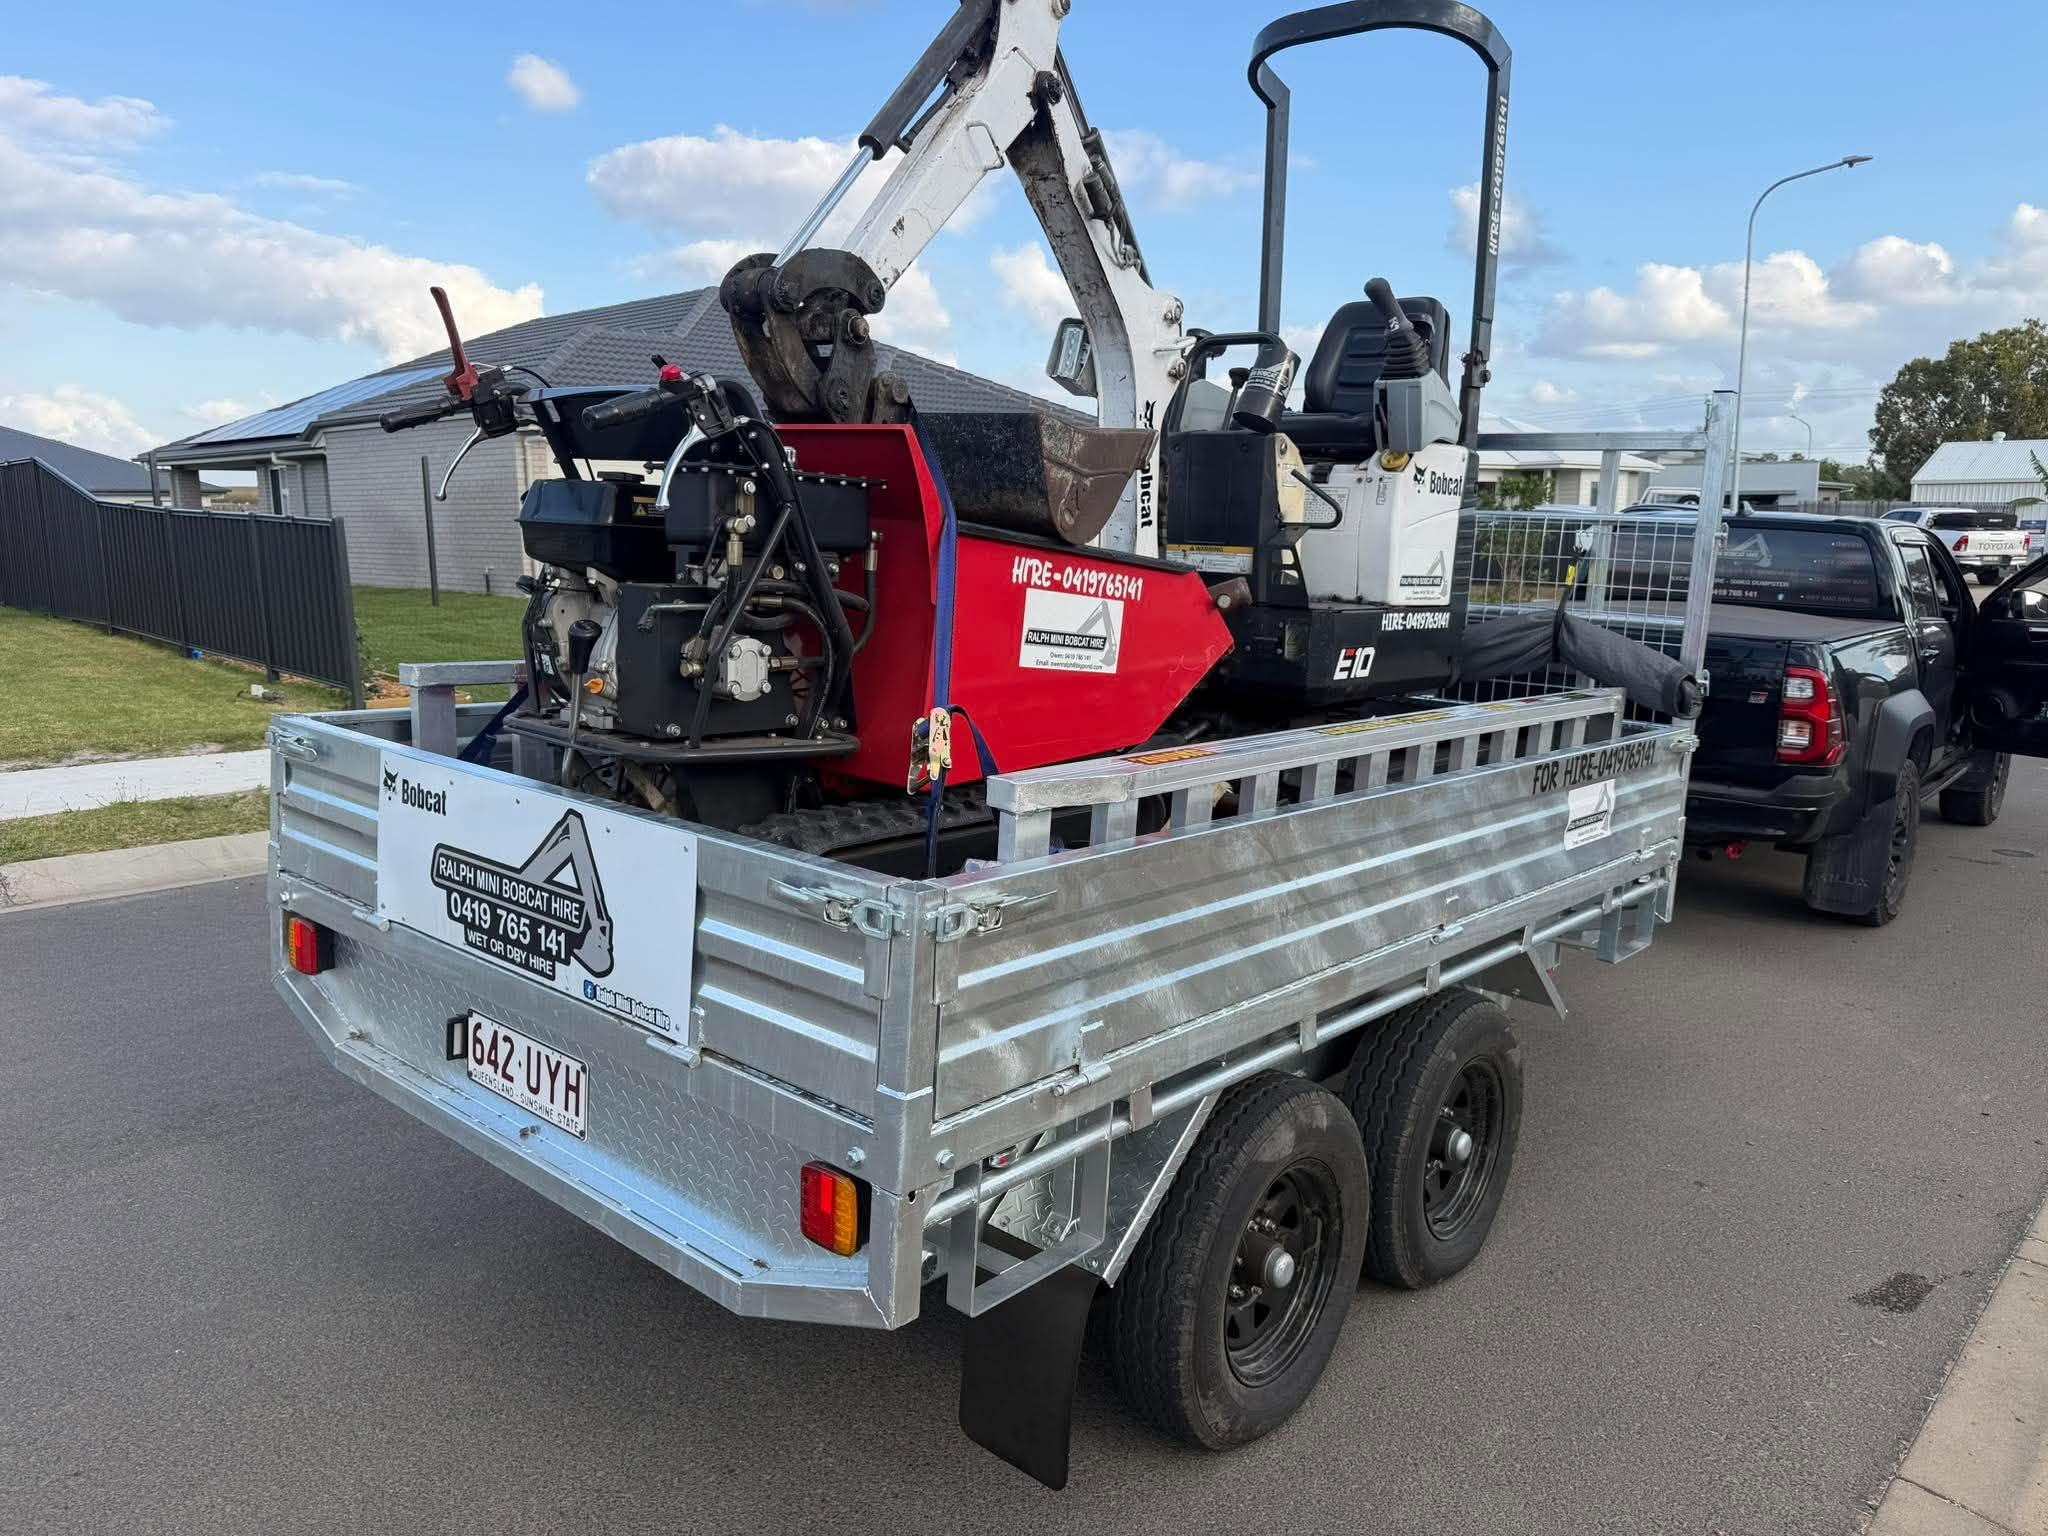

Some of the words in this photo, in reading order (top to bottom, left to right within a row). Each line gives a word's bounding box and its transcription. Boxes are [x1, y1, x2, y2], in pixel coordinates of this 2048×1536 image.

[1430, 470, 1463, 497] Bobcat
[1977, 542, 2015, 551] TOYOTA
[1012, 555, 1143, 601] HIRE-0419765141
[1027, 631, 1049, 643] RALPH
[1050, 633, 1065, 645] MINI
[1064, 635, 1090, 647] BOBCAT
[1090, 637, 1105, 649] HIRE
[1381, 611, 1451, 631] HIRE-0419765141
[1333, 646, 1376, 680] E10
[1532, 761, 1559, 795] FOR
[1563, 739, 1657, 787] HIRE-0419765141
[402, 779, 447, 817] Bobcat
[439, 856, 474, 886] RALPH
[476, 869, 500, 895] MINI
[502, 878, 549, 913] BOBCAT
[551, 895, 580, 924] HIRE
[450, 892, 491, 929] 0419
[496, 908, 531, 945] 765
[537, 925, 566, 959] 141
[467, 927, 488, 948] WET
[490, 938, 504, 954] OR
[529, 953, 553, 976] HIRE
[595, 984, 616, 1008] Ralph
[615, 992, 632, 1014] Mini
[631, 999, 656, 1025] Bobcat
[655, 1008, 670, 1032] Hire
[473, 1067, 514, 1098] QUEENSLAND
[520, 1092, 554, 1120] SUNSHINE
[557, 1112, 580, 1133] STATE
